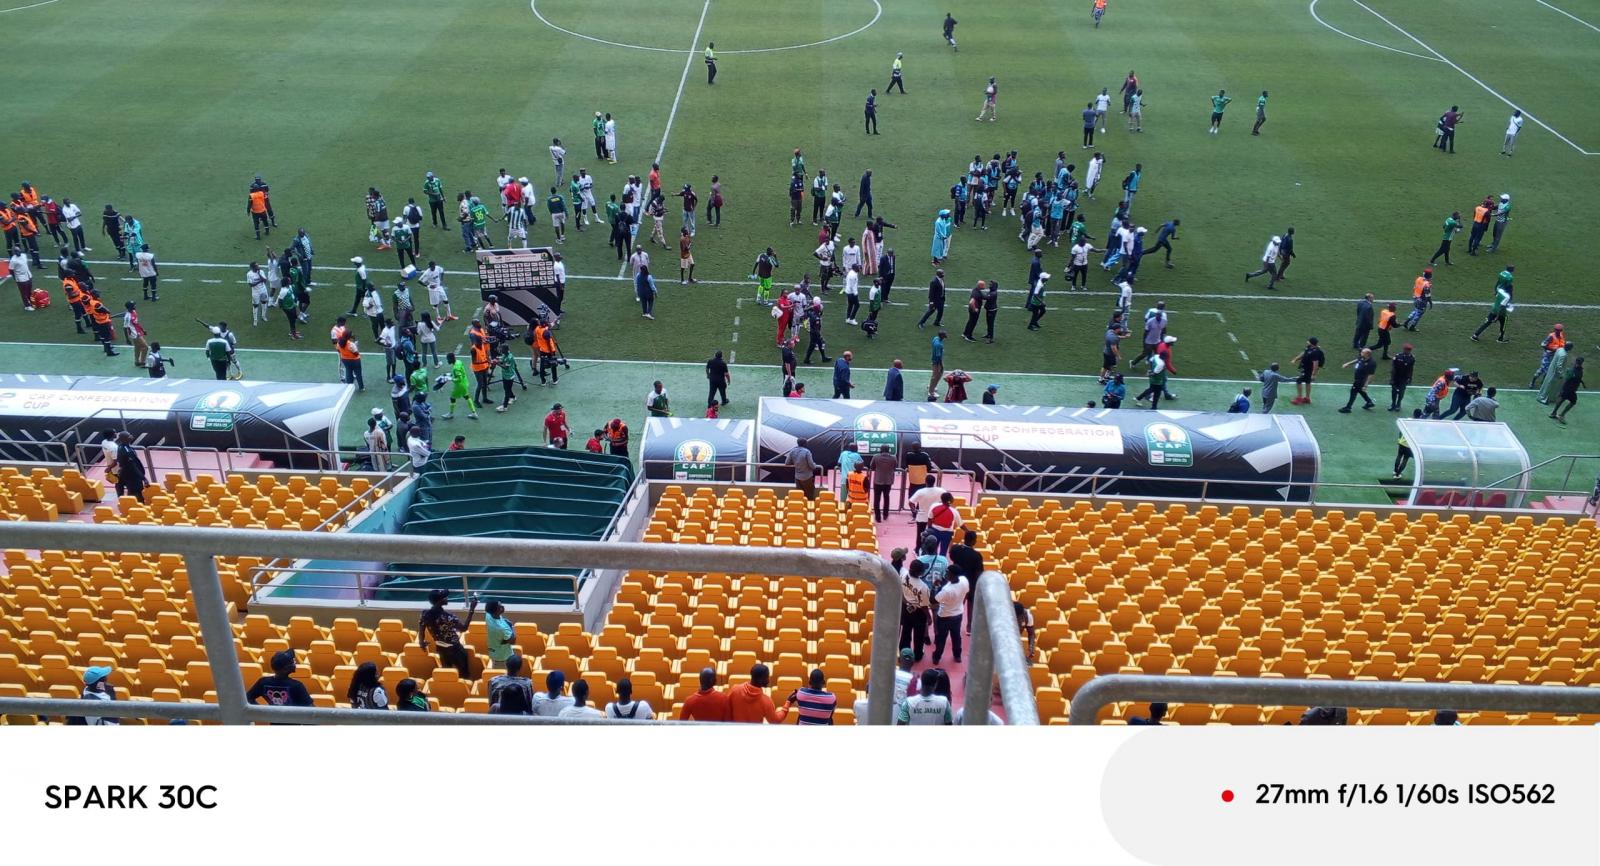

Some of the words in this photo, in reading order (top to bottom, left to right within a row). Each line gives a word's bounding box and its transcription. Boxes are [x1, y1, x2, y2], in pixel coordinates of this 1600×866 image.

[23, 401, 50, 409] CUP
[58, 393, 171, 405] CONFEDERATION
[1002, 425, 1115, 437] CONFEDERATION
